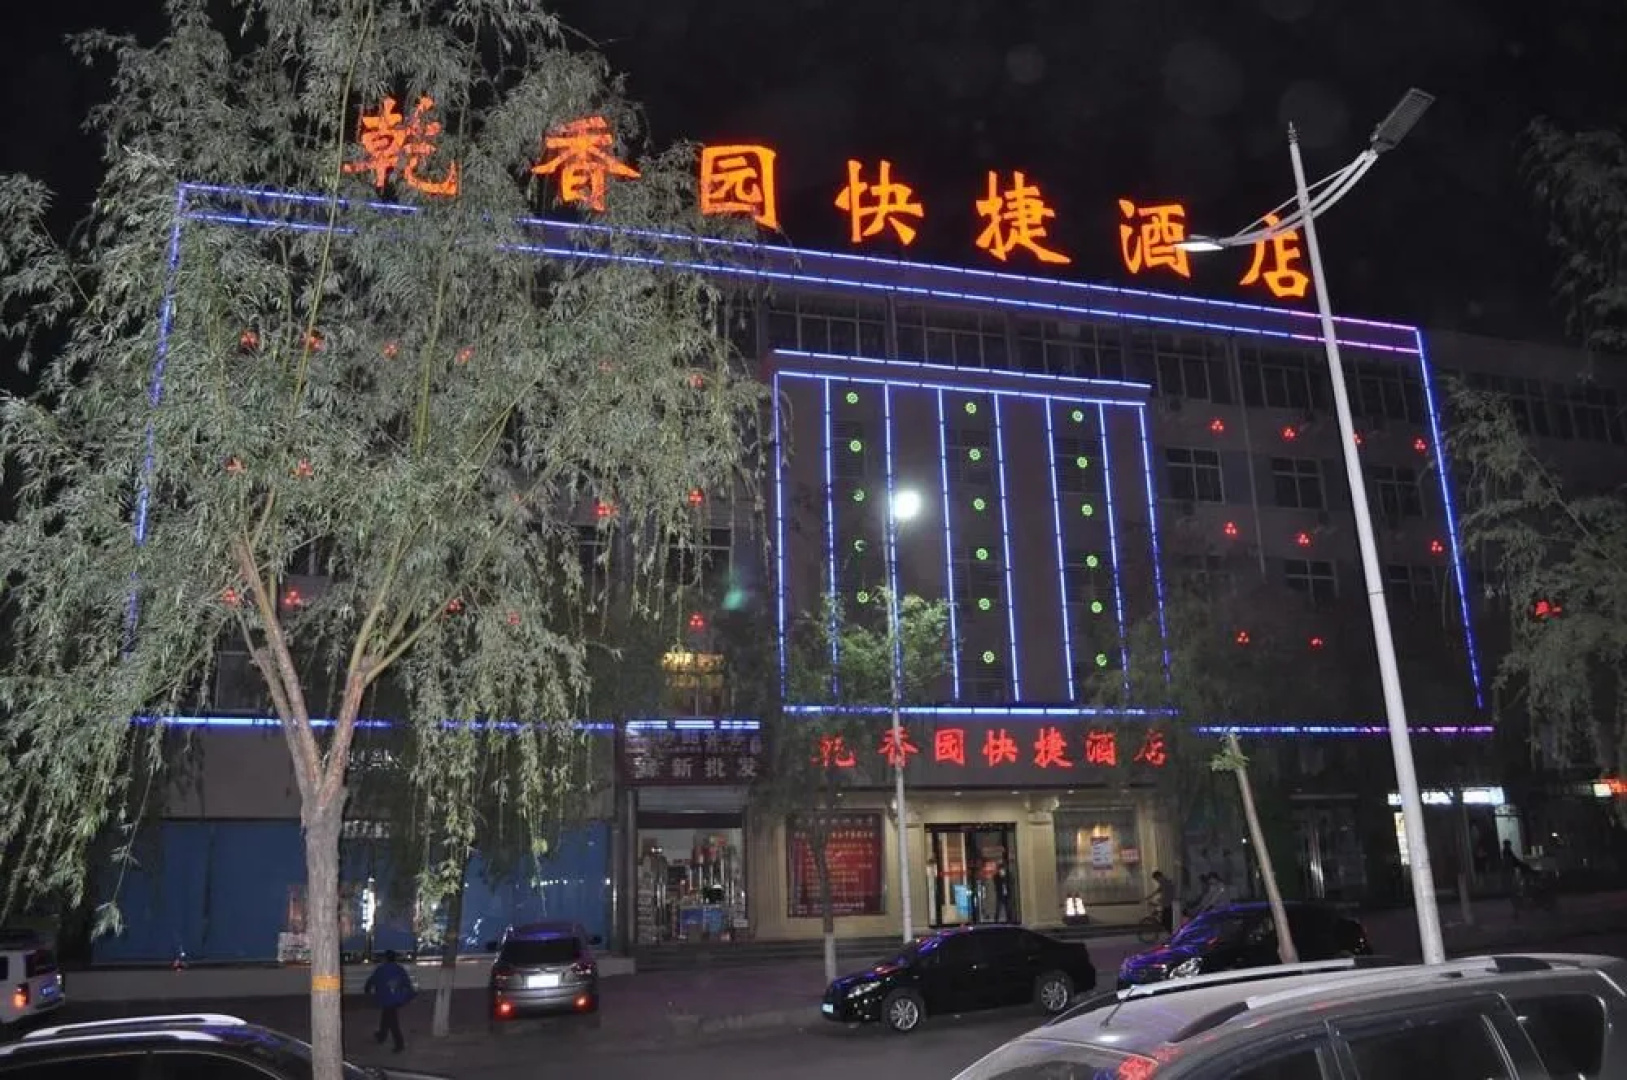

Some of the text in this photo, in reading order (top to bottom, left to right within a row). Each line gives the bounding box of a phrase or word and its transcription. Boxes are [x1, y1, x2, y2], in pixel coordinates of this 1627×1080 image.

[343, 97, 1312, 298] 乾香园快捷酒店
